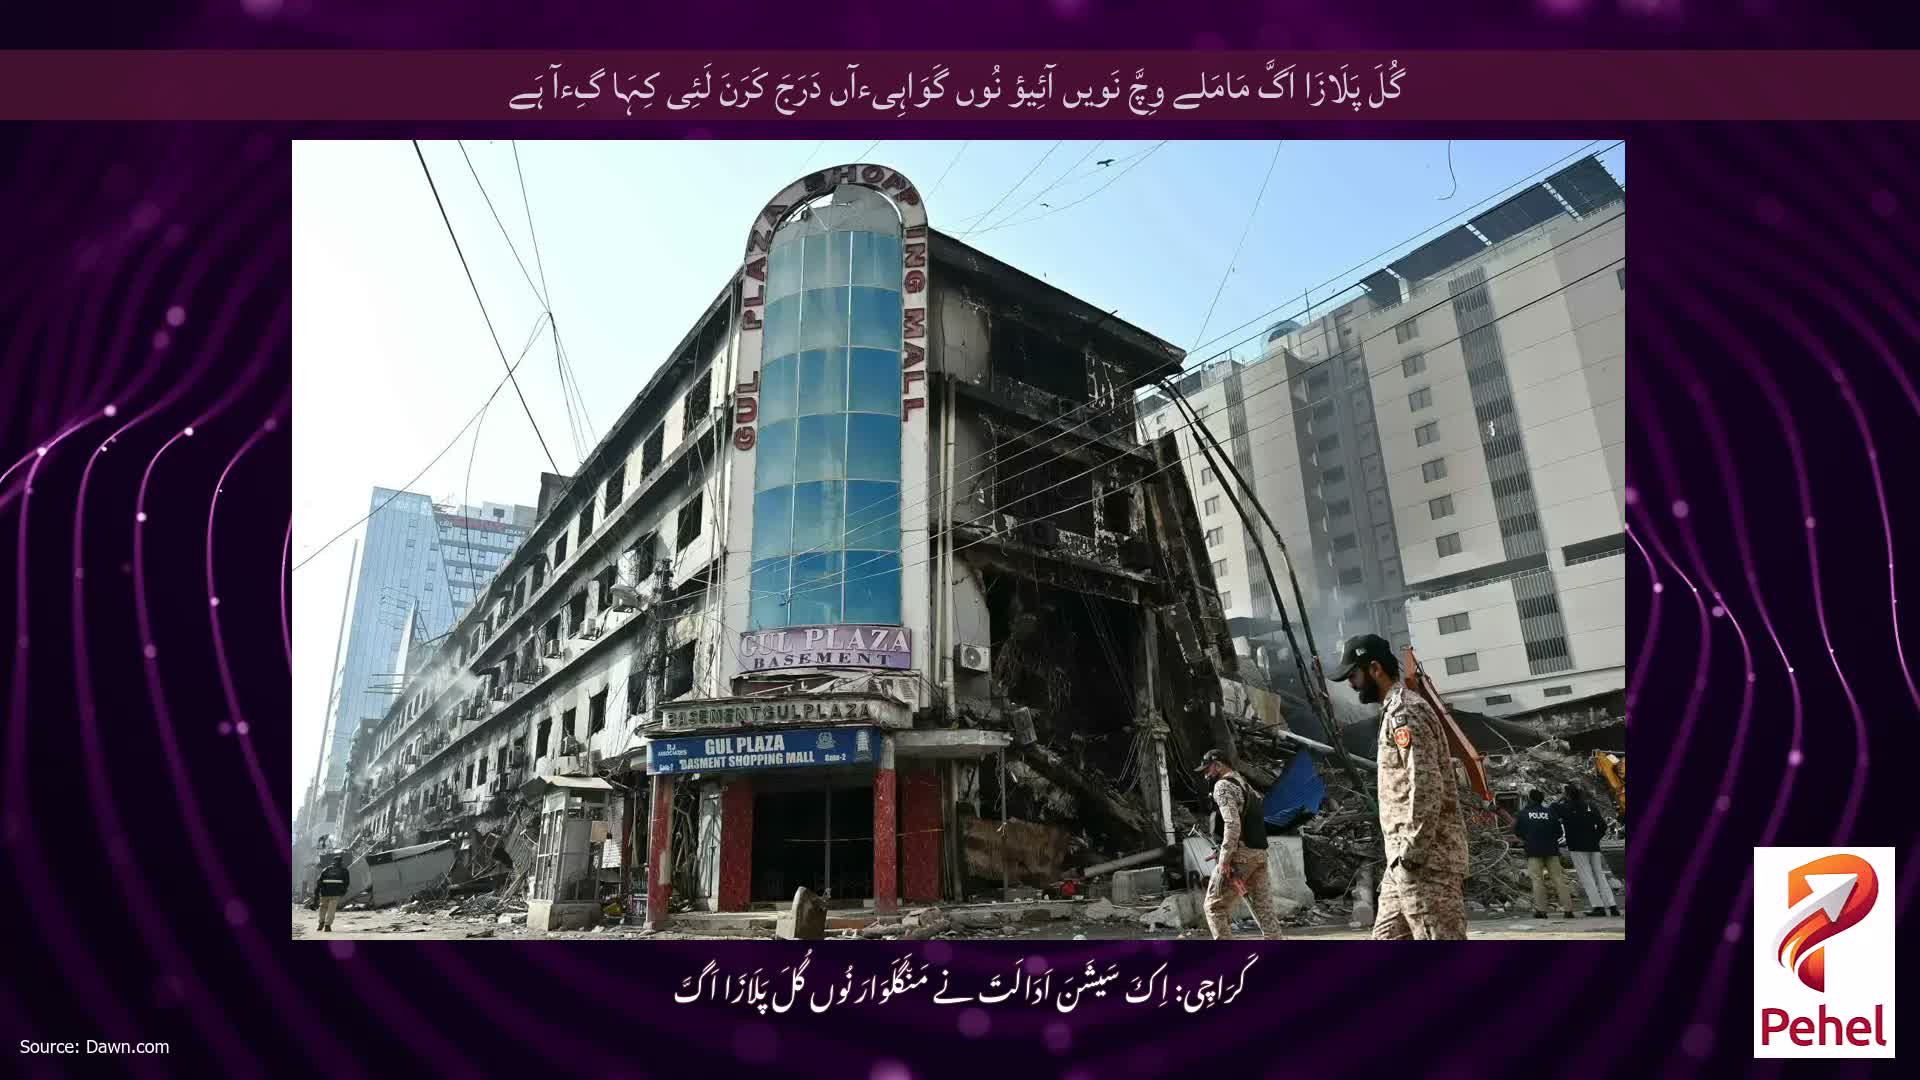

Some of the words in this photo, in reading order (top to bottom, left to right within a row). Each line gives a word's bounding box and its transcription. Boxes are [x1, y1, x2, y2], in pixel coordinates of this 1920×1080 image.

[743, 203, 788, 331] PLAZA
[903, 308, 926, 423] MALL
[734, 371, 759, 451] GUL
[740, 631, 794, 658] GUL
[803, 627, 911, 654] PLAZA
[753, 652, 892, 669] BASEMENT
[704, 736, 735, 755] GUL
[739, 734, 785, 753] PLAZA
[729, 752, 783, 767] SHOPPING
[785, 750, 815, 764] MALL
[1528, 811, 1549, 820] POLICE
